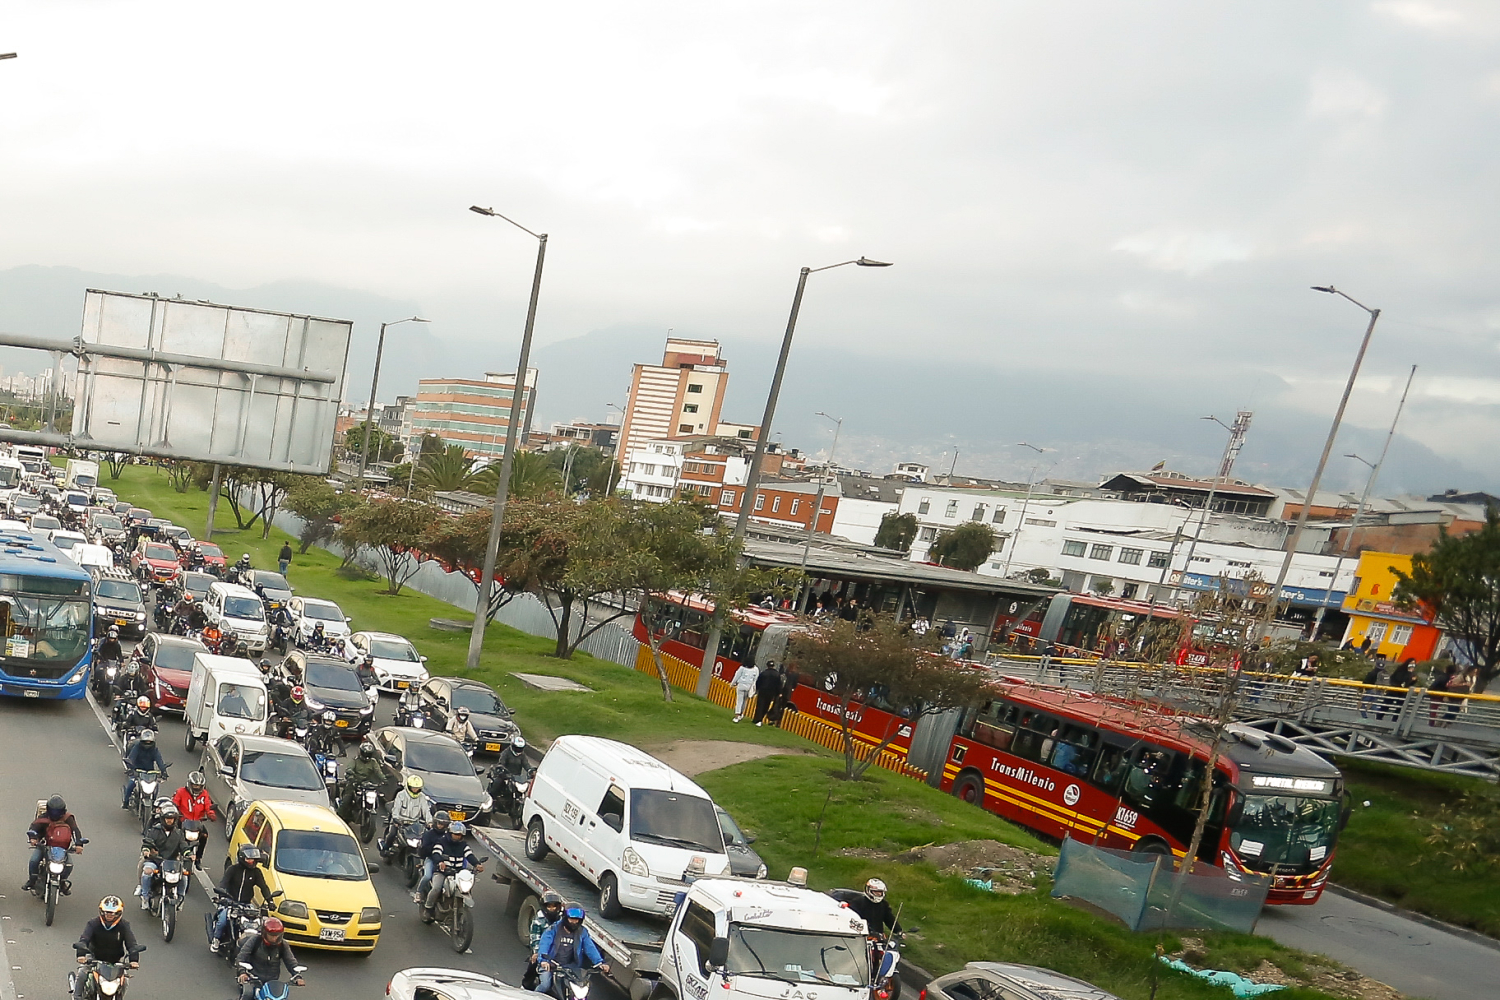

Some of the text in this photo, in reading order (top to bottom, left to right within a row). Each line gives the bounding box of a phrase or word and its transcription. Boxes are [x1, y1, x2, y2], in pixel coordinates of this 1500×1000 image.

[991, 757, 1055, 792] TransMilenio
[1116, 806, 1138, 825] K1659
[780, 989, 818, 1000] JAC
